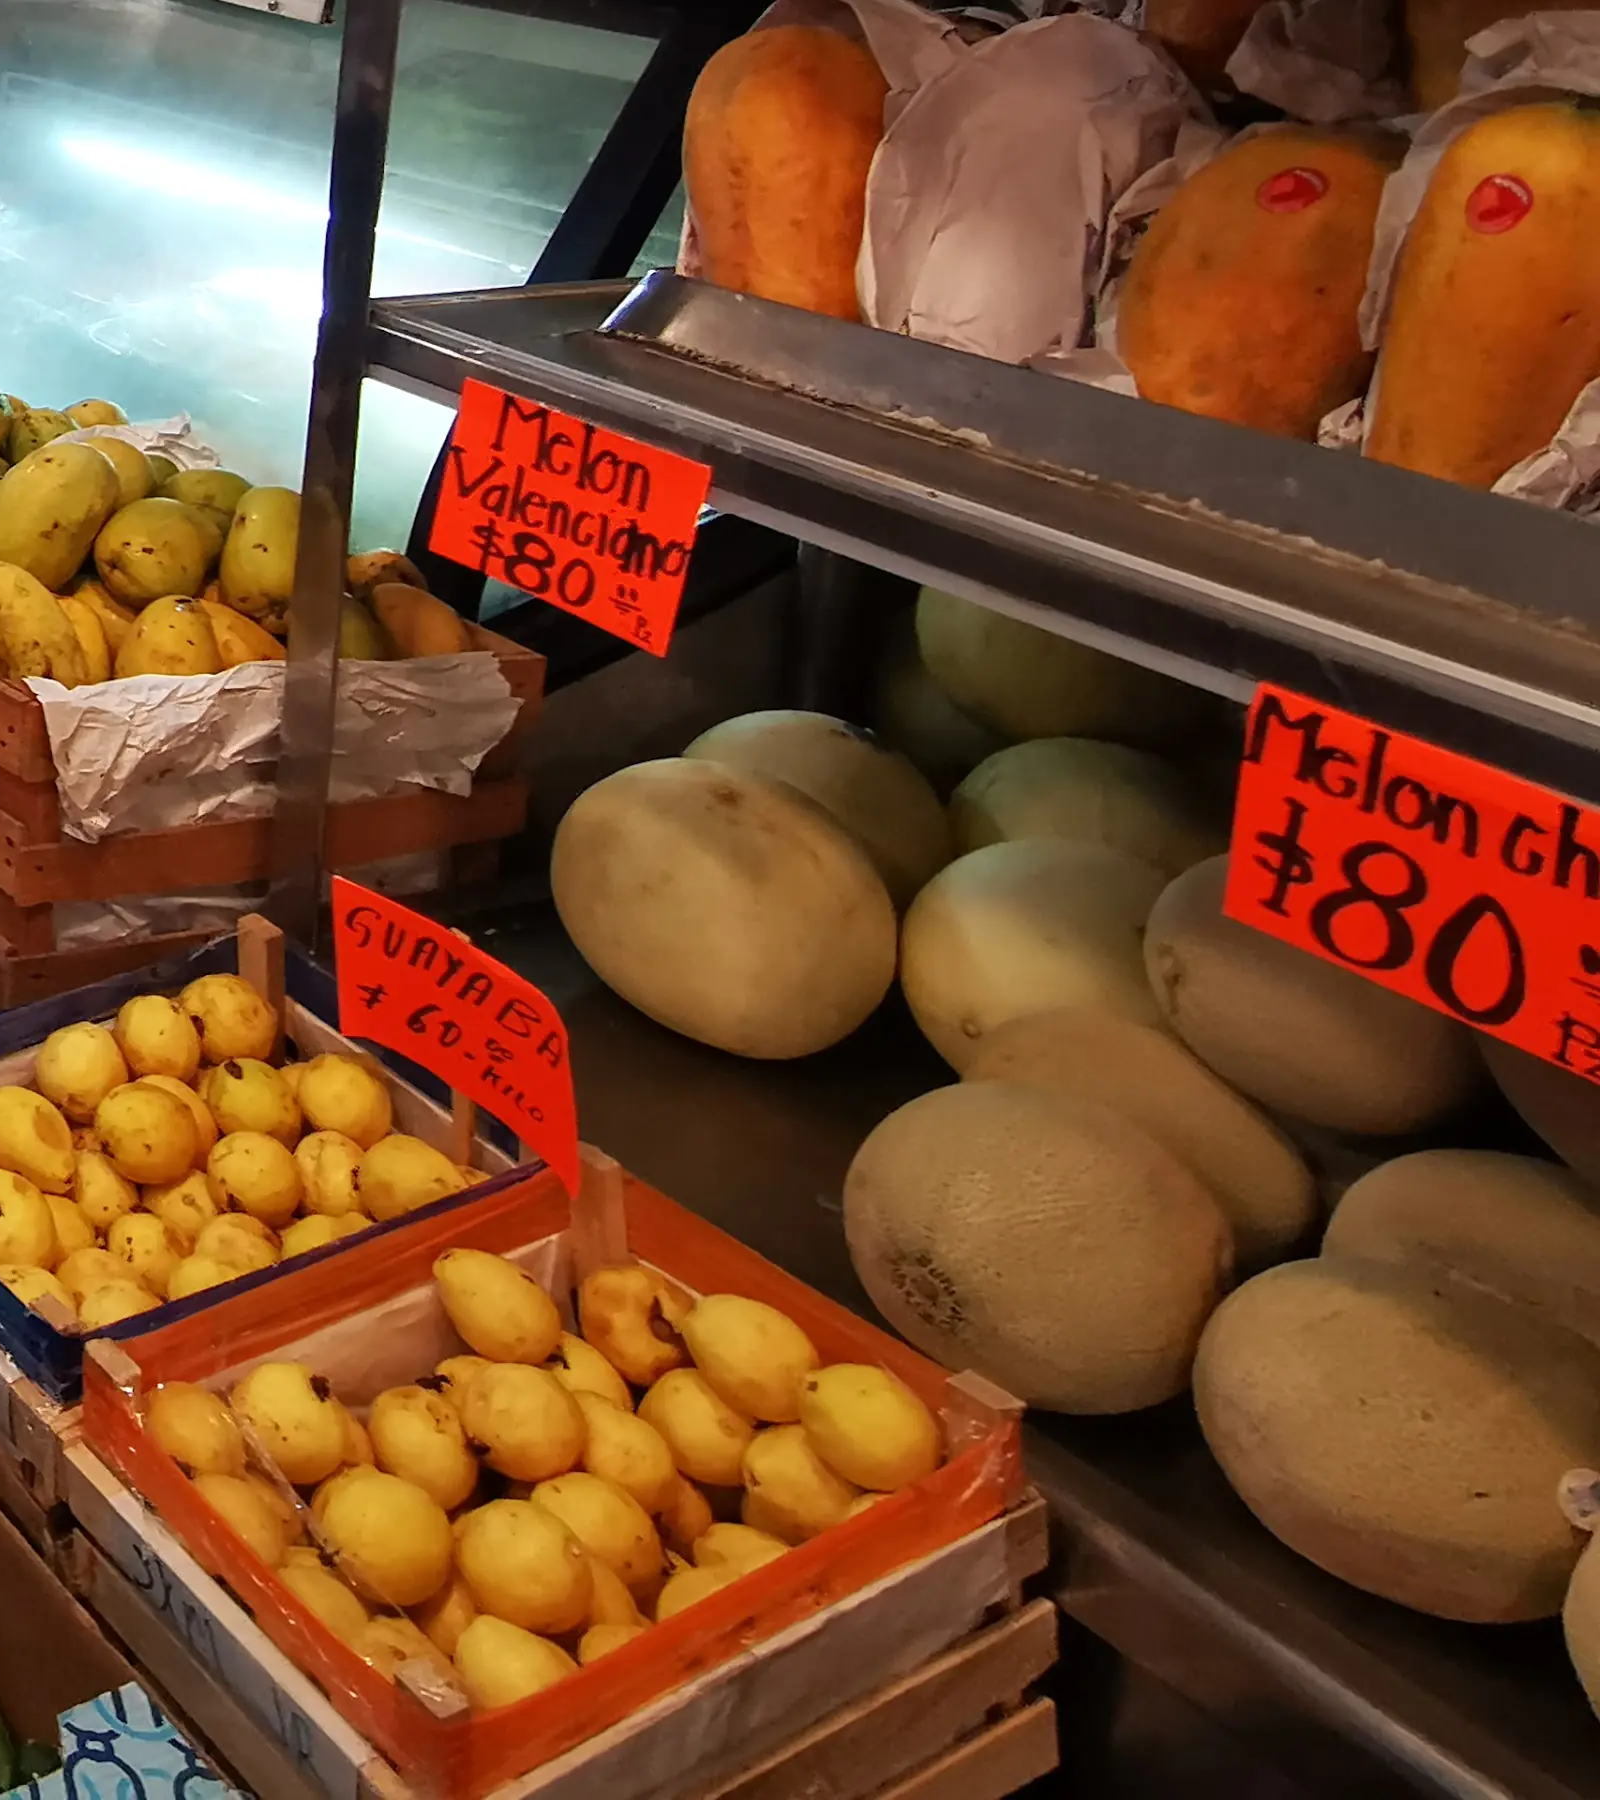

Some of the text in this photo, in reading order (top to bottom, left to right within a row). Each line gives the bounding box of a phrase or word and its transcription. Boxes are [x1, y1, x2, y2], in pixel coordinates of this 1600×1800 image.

[450, 444, 694, 581] Valenciano
[494, 394, 651, 513] Melon
[471, 519, 596, 609] $80
[1243, 694, 1478, 859] Melon
[1252, 796, 1525, 1025] $80
[345, 906, 563, 1068] GUAYABA
[480, 1066, 543, 1122] KILO
